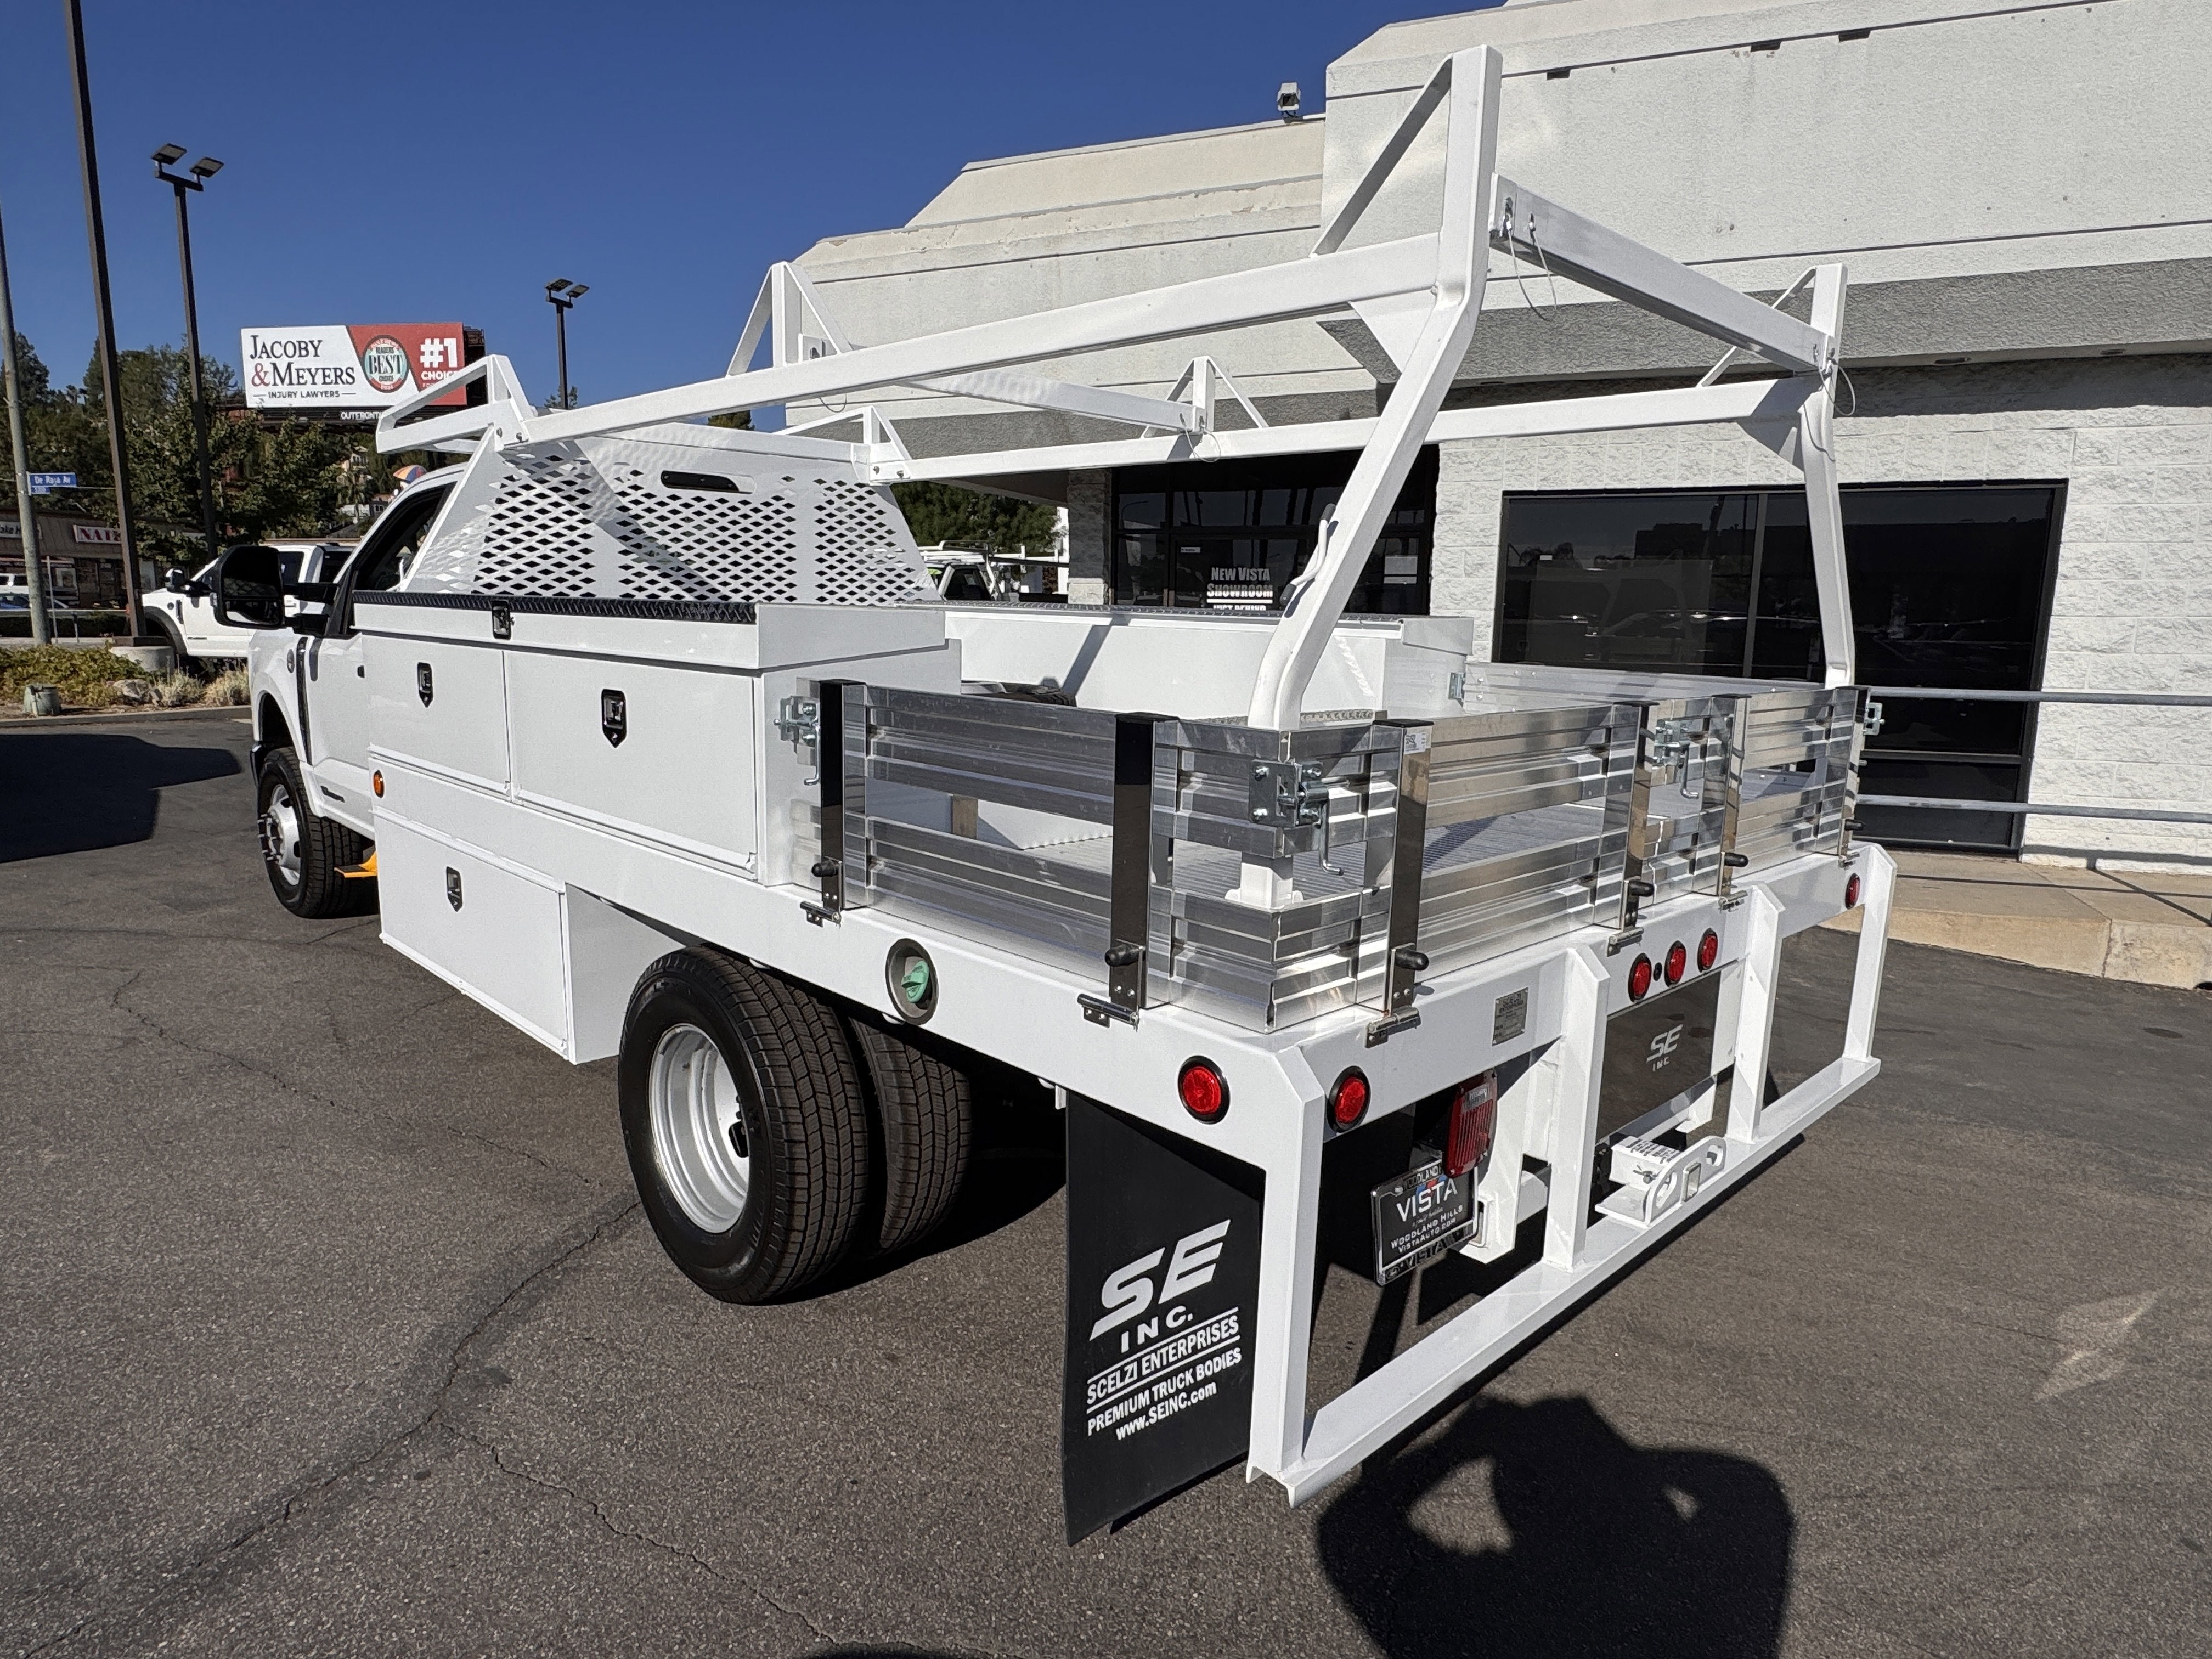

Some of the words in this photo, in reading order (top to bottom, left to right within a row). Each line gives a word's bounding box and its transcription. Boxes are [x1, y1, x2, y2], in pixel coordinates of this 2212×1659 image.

[250, 335, 323, 359] JACOBY
[368, 354, 403, 374] BEST
[420, 338, 458, 368] #1
[421, 370, 458, 380] CHOIC
[1207, 583, 1273, 597] SHOWROOM
[1211, 567, 1236, 580] NEW
[1238, 567, 1271, 580] VISTA
[1396, 1179, 1458, 1222] VISTA
[1391, 1219, 1438, 1249] WOODLAND
[1441, 1204, 1463, 1222] HILLS
[1090, 1219, 1231, 1341] SE
[1121, 1306, 1193, 1353] INC.
[1086, 1361, 1138, 1404] SCELZI
[1141, 1315, 1239, 1376] ENTERPRISES
[1087, 1389, 1150, 1436] PREMIUM
[1152, 1368, 1195, 1402] TRUCK
[1196, 1347, 1242, 1381] BODIES
[1116, 1381, 1217, 1441] www.SEINC.com
